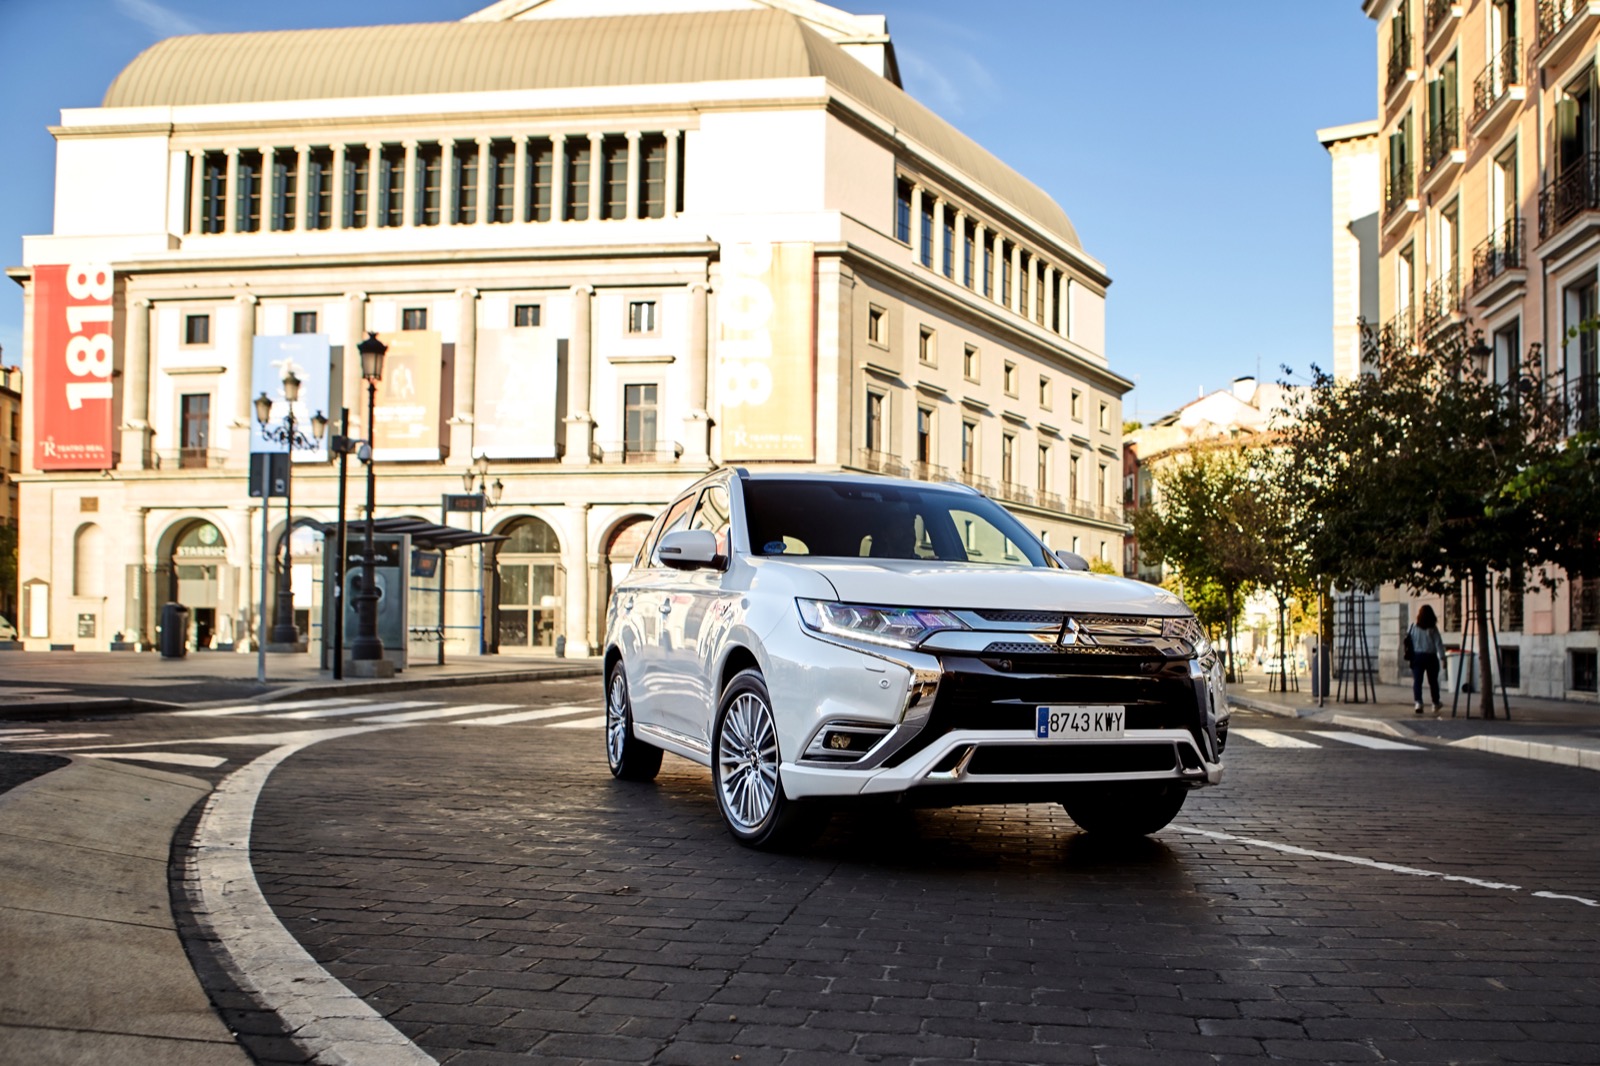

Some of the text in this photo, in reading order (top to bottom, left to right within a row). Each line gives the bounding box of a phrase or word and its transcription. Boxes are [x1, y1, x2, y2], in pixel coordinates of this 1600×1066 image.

[66, 263, 114, 411] 1818
[56, 444, 104, 452] TEATRO REAL
[1040, 725, 1047, 734] E
[1050, 712, 1123, 733] 8743 KWY
